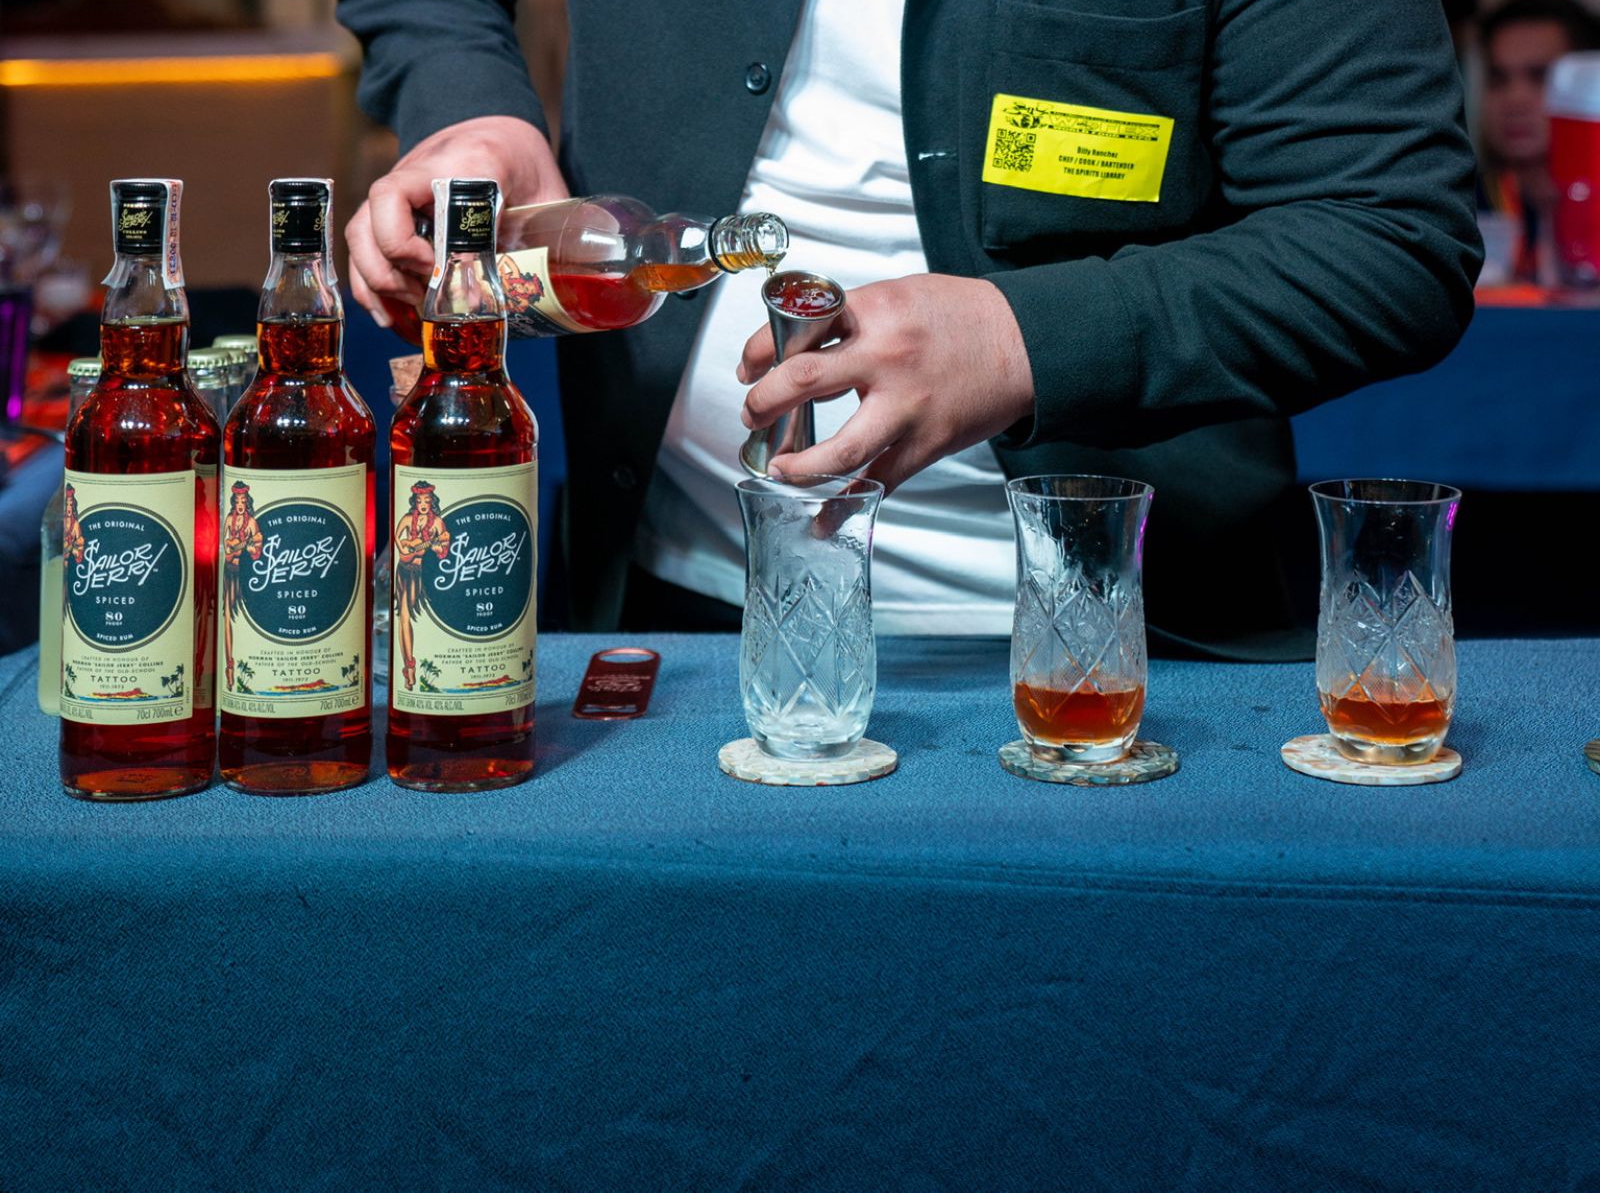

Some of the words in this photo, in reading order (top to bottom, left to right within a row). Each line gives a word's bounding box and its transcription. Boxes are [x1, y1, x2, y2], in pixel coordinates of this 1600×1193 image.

[1059, 155, 1074, 163] CHEF
[1079, 158, 1096, 166] COOK
[1101, 161, 1135, 170] BARTENDER
[1064, 167, 1074, 175] THE
[1076, 168, 1099, 177] SPIRITS
[1101, 170, 1125, 179] LIBRARY
[268, 517, 282, 527] THE
[286, 515, 326, 525] ORIGINAL
[456, 517, 471, 526] THE
[475, 513, 511, 522] ORIGINAL
[88, 522, 101, 531] THE
[105, 520, 144, 531] ORIGINAL
[277, 590, 318, 598] SPICED
[465, 587, 504, 596] SPICED
[96, 596, 135, 604] SPICED
[288, 605, 306, 615] 80
[476, 602, 493, 611] 80
[105, 611, 123, 621] 80
[278, 627, 300, 635] SPICED
[303, 626, 317, 634] RUM
[96, 633, 117, 641] SPICED
[272, 667, 321, 676] TATTOO
[461, 664, 506, 674] TATTOO
[90, 675, 138, 683] TATTOO
[320, 700, 333, 710] 70cl
[136, 709, 151, 719] 70cl
